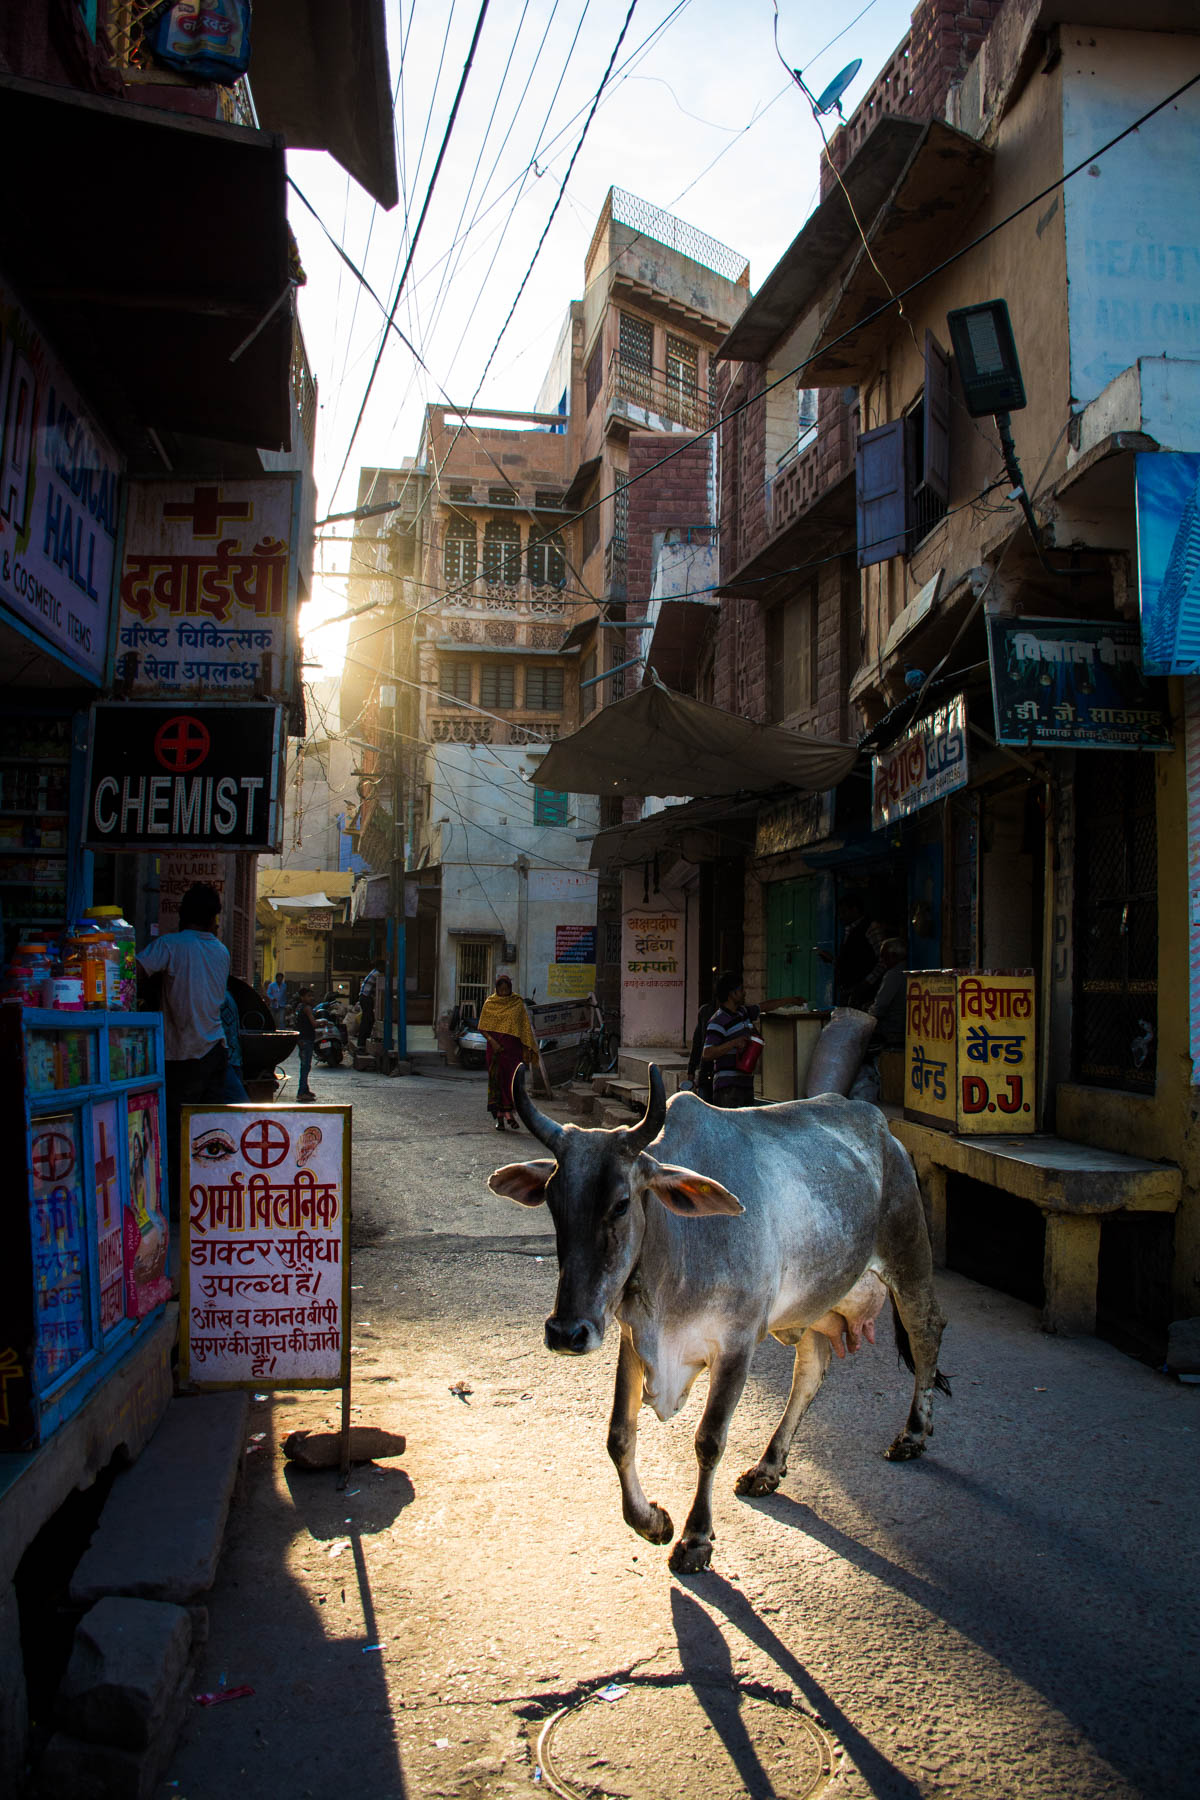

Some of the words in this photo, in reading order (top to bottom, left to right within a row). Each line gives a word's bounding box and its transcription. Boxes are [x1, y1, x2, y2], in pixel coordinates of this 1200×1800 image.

[46, 385, 115, 540] MEDICAL
[44, 482, 98, 603] HALL
[2, 550, 10, 581] &
[14, 563, 62, 627] COSMETIC
[176, 621, 272, 652] चिकित्सक
[144, 654, 179, 680] सेवा
[182, 661, 259, 683] उपलब्ध
[1014, 700, 1047, 721] डी.
[1053, 702, 1084, 722] जे.
[874, 734, 925, 819] विशाल
[94, 775, 264, 836] CHEMIST
[627, 914, 680, 933] अक्षयदीप
[627, 957, 679, 973] कम्पनी
[907, 982, 955, 1041] विशाल
[959, 979, 1032, 1021] विशाल
[966, 1025, 1026, 1063] बैन्ड
[912, 1045, 947, 1101] बैन्ड
[962, 1075, 1031, 1113] D.J.
[190, 1172, 244, 1234] शर्मा
[248, 1170, 337, 1227] क्लिनिक
[190, 1240, 274, 1266] डाक्टर
[274, 1230, 341, 1269] सुविधा
[192, 1300, 233, 1330] आँख
[236, 1310, 251, 1328] व
[253, 1307, 295, 1327] कान
[295, 1307, 307, 1326] व
[307, 1299, 338, 1324] बीपी
[228, 1331, 250, 1355] की
[288, 1328, 309, 1352] की
[308, 1326, 340, 1352] जाती
